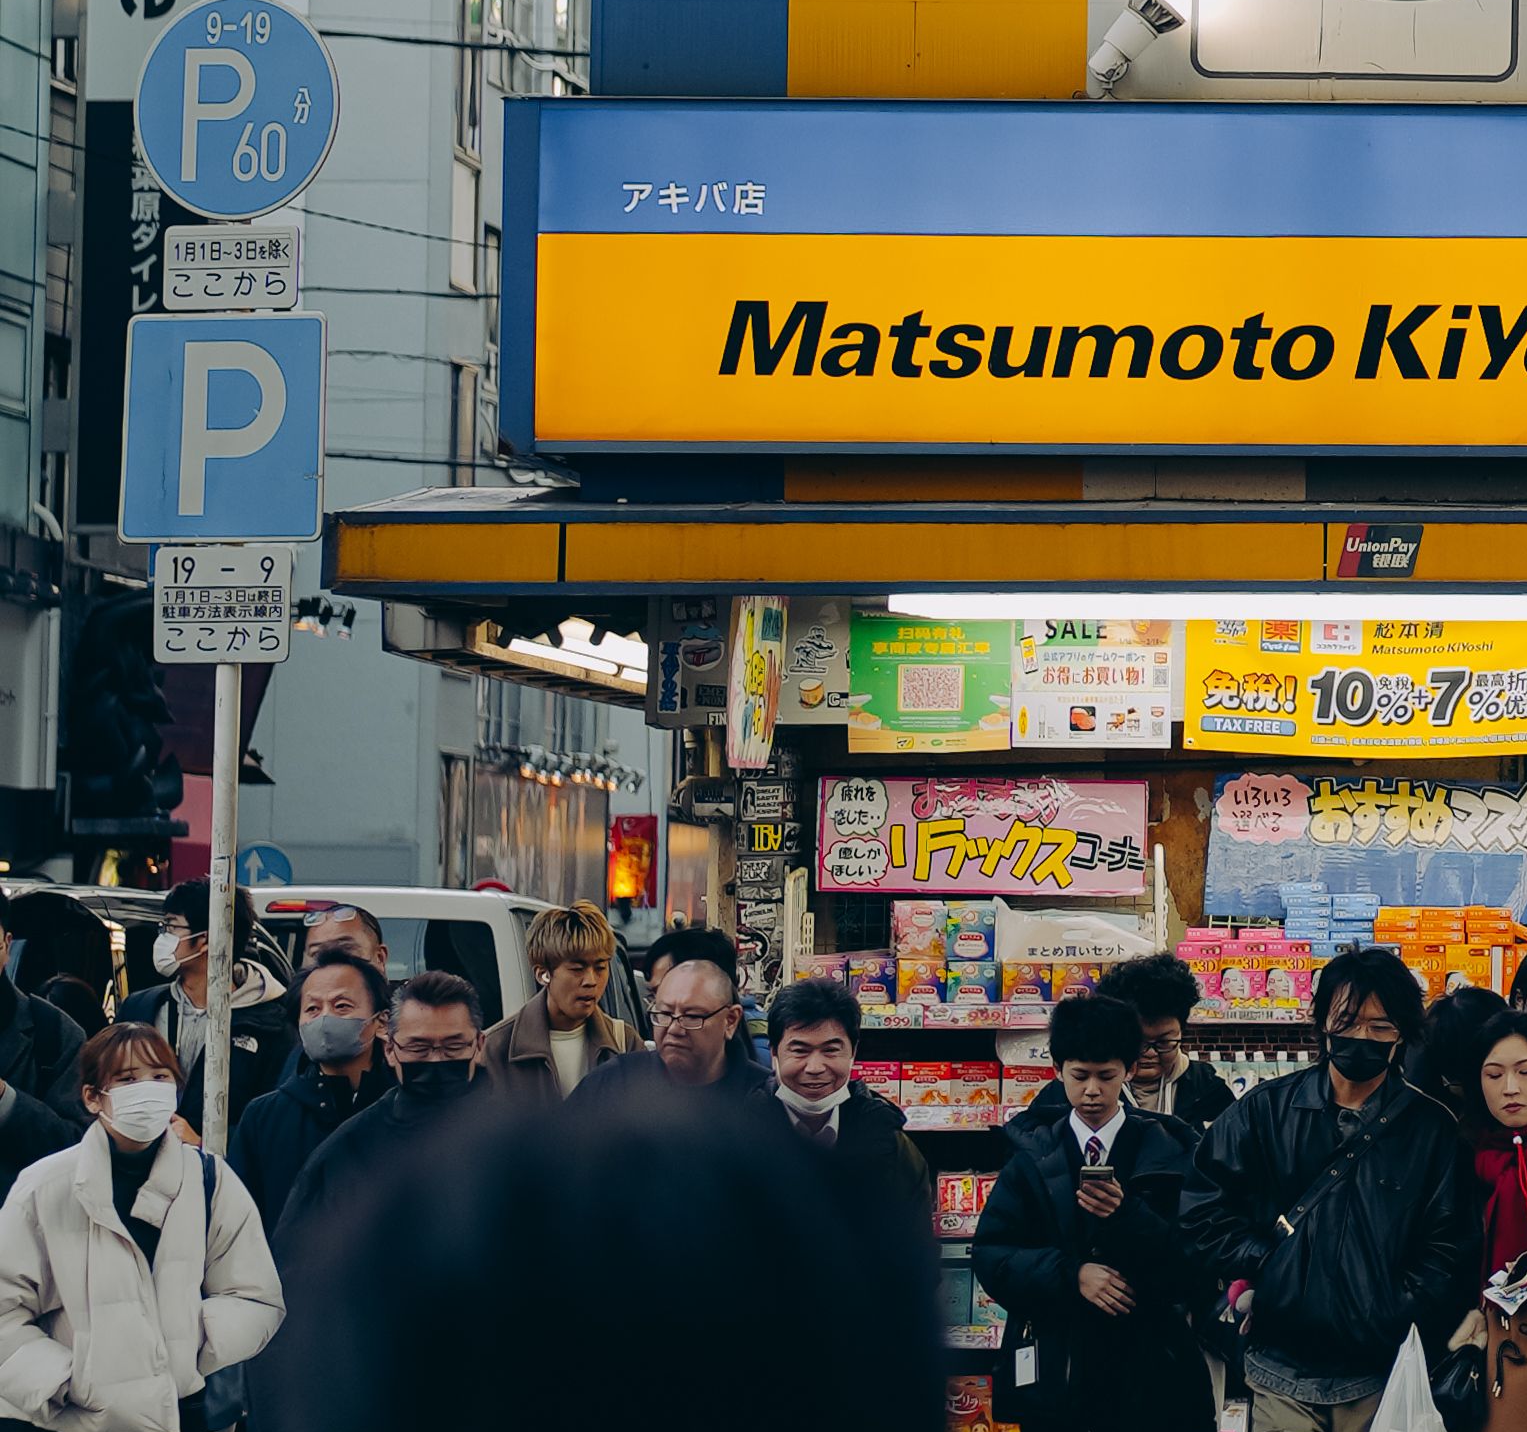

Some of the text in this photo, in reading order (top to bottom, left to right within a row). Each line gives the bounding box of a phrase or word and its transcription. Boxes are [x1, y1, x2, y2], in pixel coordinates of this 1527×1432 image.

[206, 11, 272, 45] 9-19
[181, 46, 257, 182] P
[293, 87, 312, 124] 分
[232, 122, 287, 183] 60
[621, 181, 767, 216] アキバ店
[172, 270, 287, 298] ここから
[718, 300, 1335, 381] Matsumoto
[177, 339, 287, 518] P
[1346, 537, 1418, 565] UnionPay
[166, 626, 280, 652] ここから
[1372, 643, 1445, 655] Matsumoto
[1214, 717, 1281, 734] TAX FREE
[1028, 943, 1125, 957] まとめ買いセット
